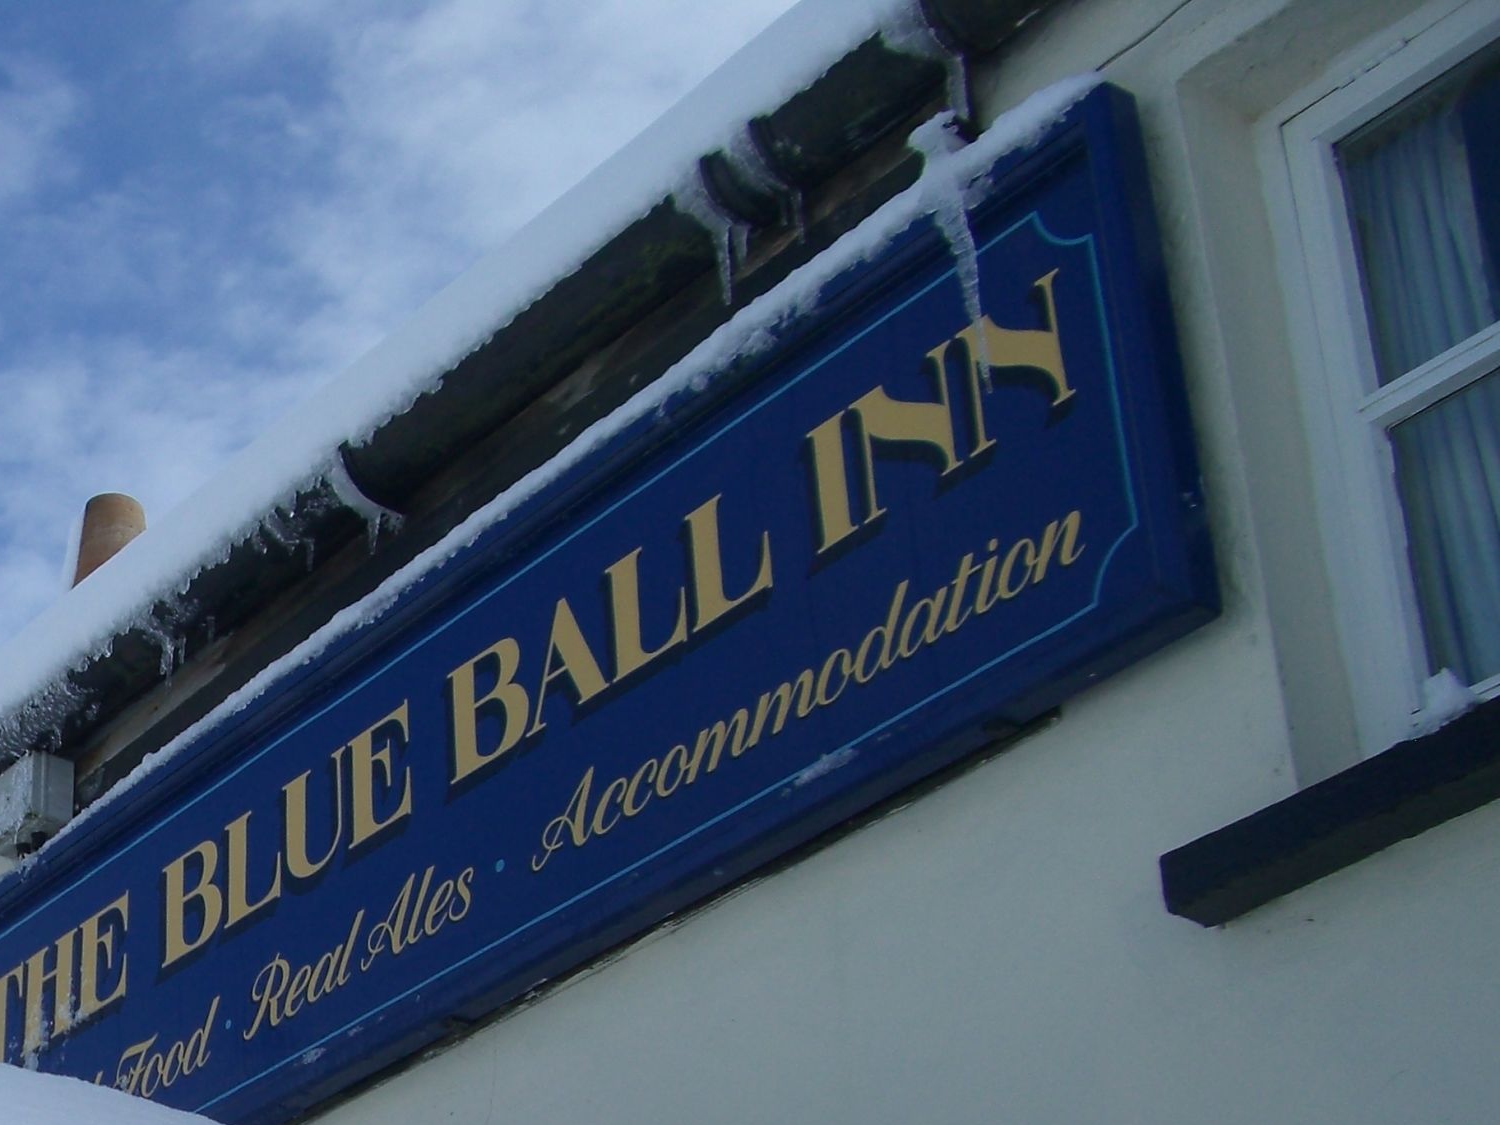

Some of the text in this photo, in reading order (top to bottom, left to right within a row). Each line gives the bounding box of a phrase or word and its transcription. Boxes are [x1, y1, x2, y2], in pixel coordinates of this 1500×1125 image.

[160, 698, 412, 970] BLUE
[445, 493, 775, 786] BALL
[806, 268, 1078, 556] INN
[242, 908, 365, 1042] Real
[360, 864, 476, 972] Ales
[530, 509, 1086, 871] Accommodation
